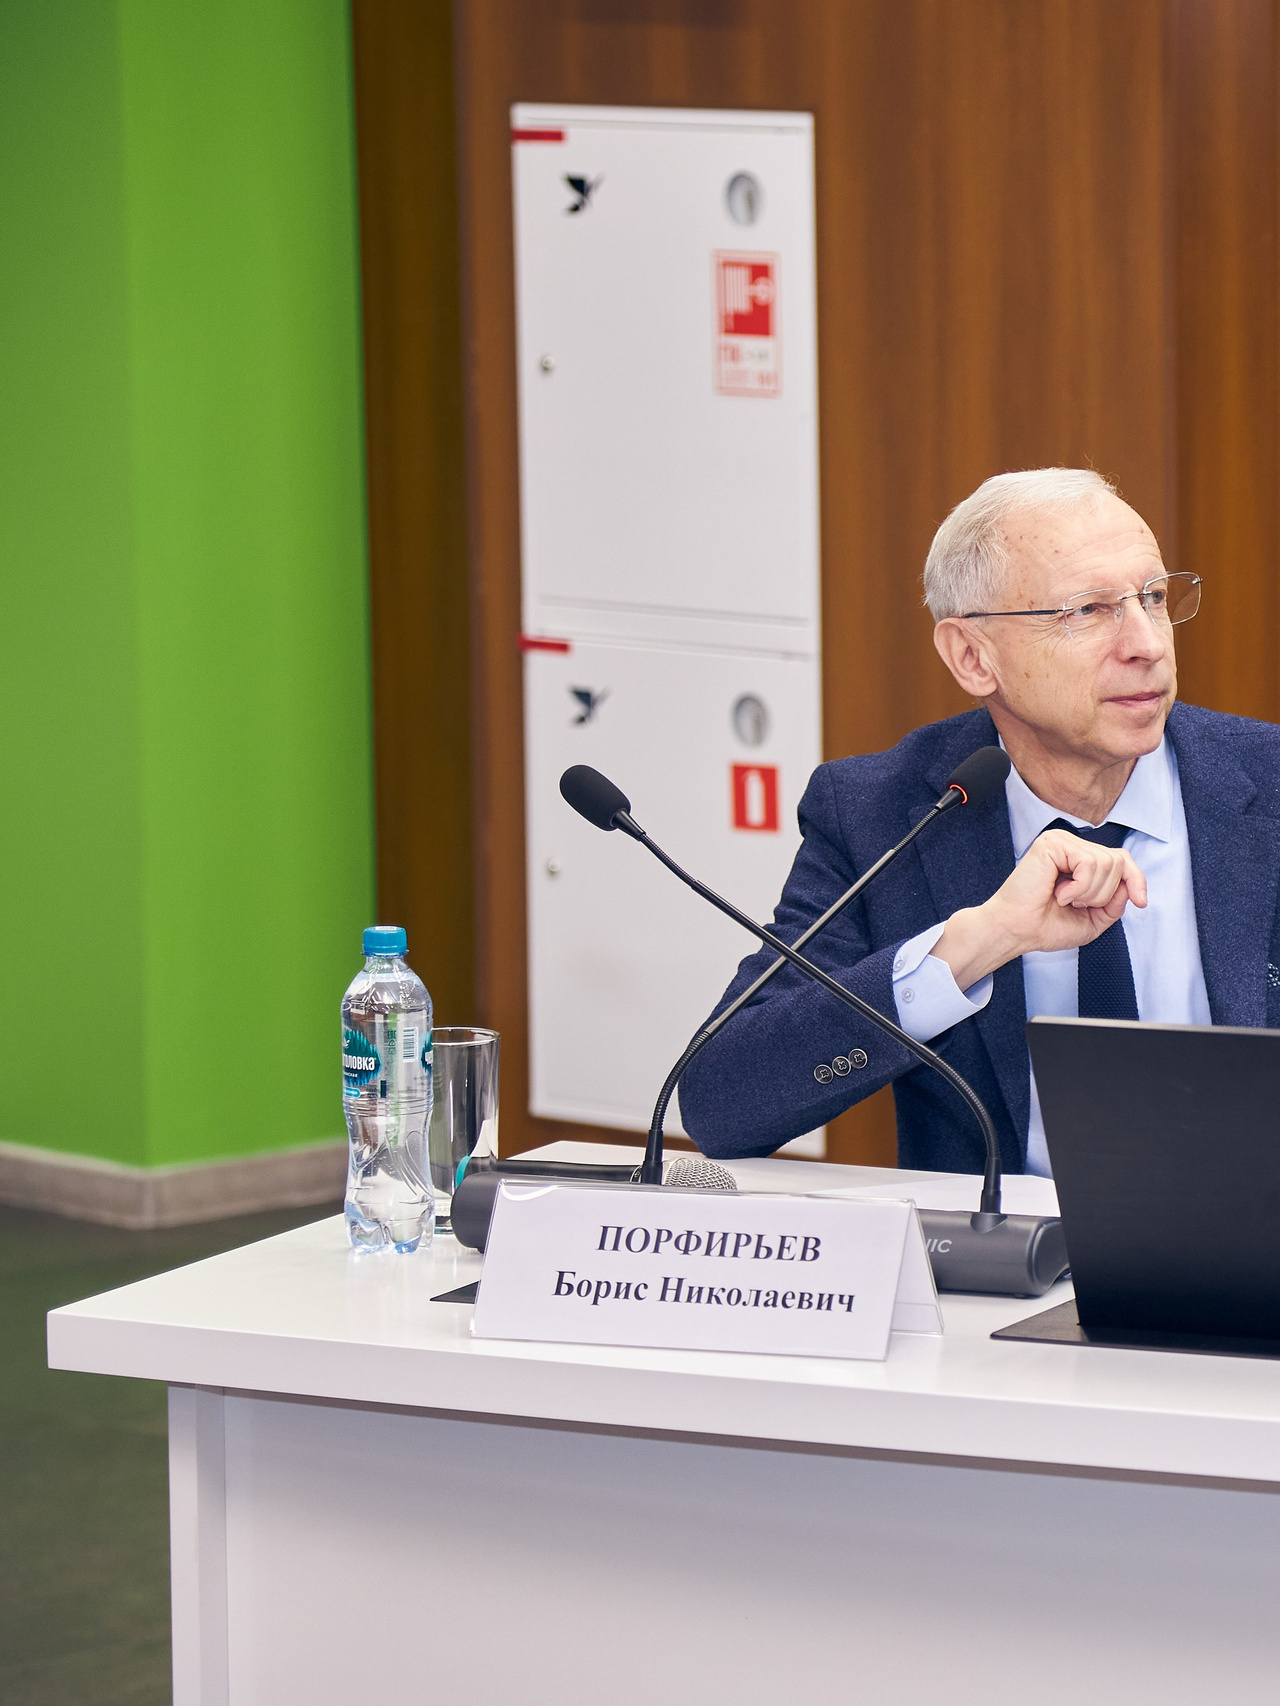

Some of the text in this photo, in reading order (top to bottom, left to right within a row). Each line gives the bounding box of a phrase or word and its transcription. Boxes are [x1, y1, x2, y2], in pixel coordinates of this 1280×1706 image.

[596, 1224, 822, 1262] ПОРФИРЬЕВ
[551, 1270, 856, 1313] Борис Николаевич
